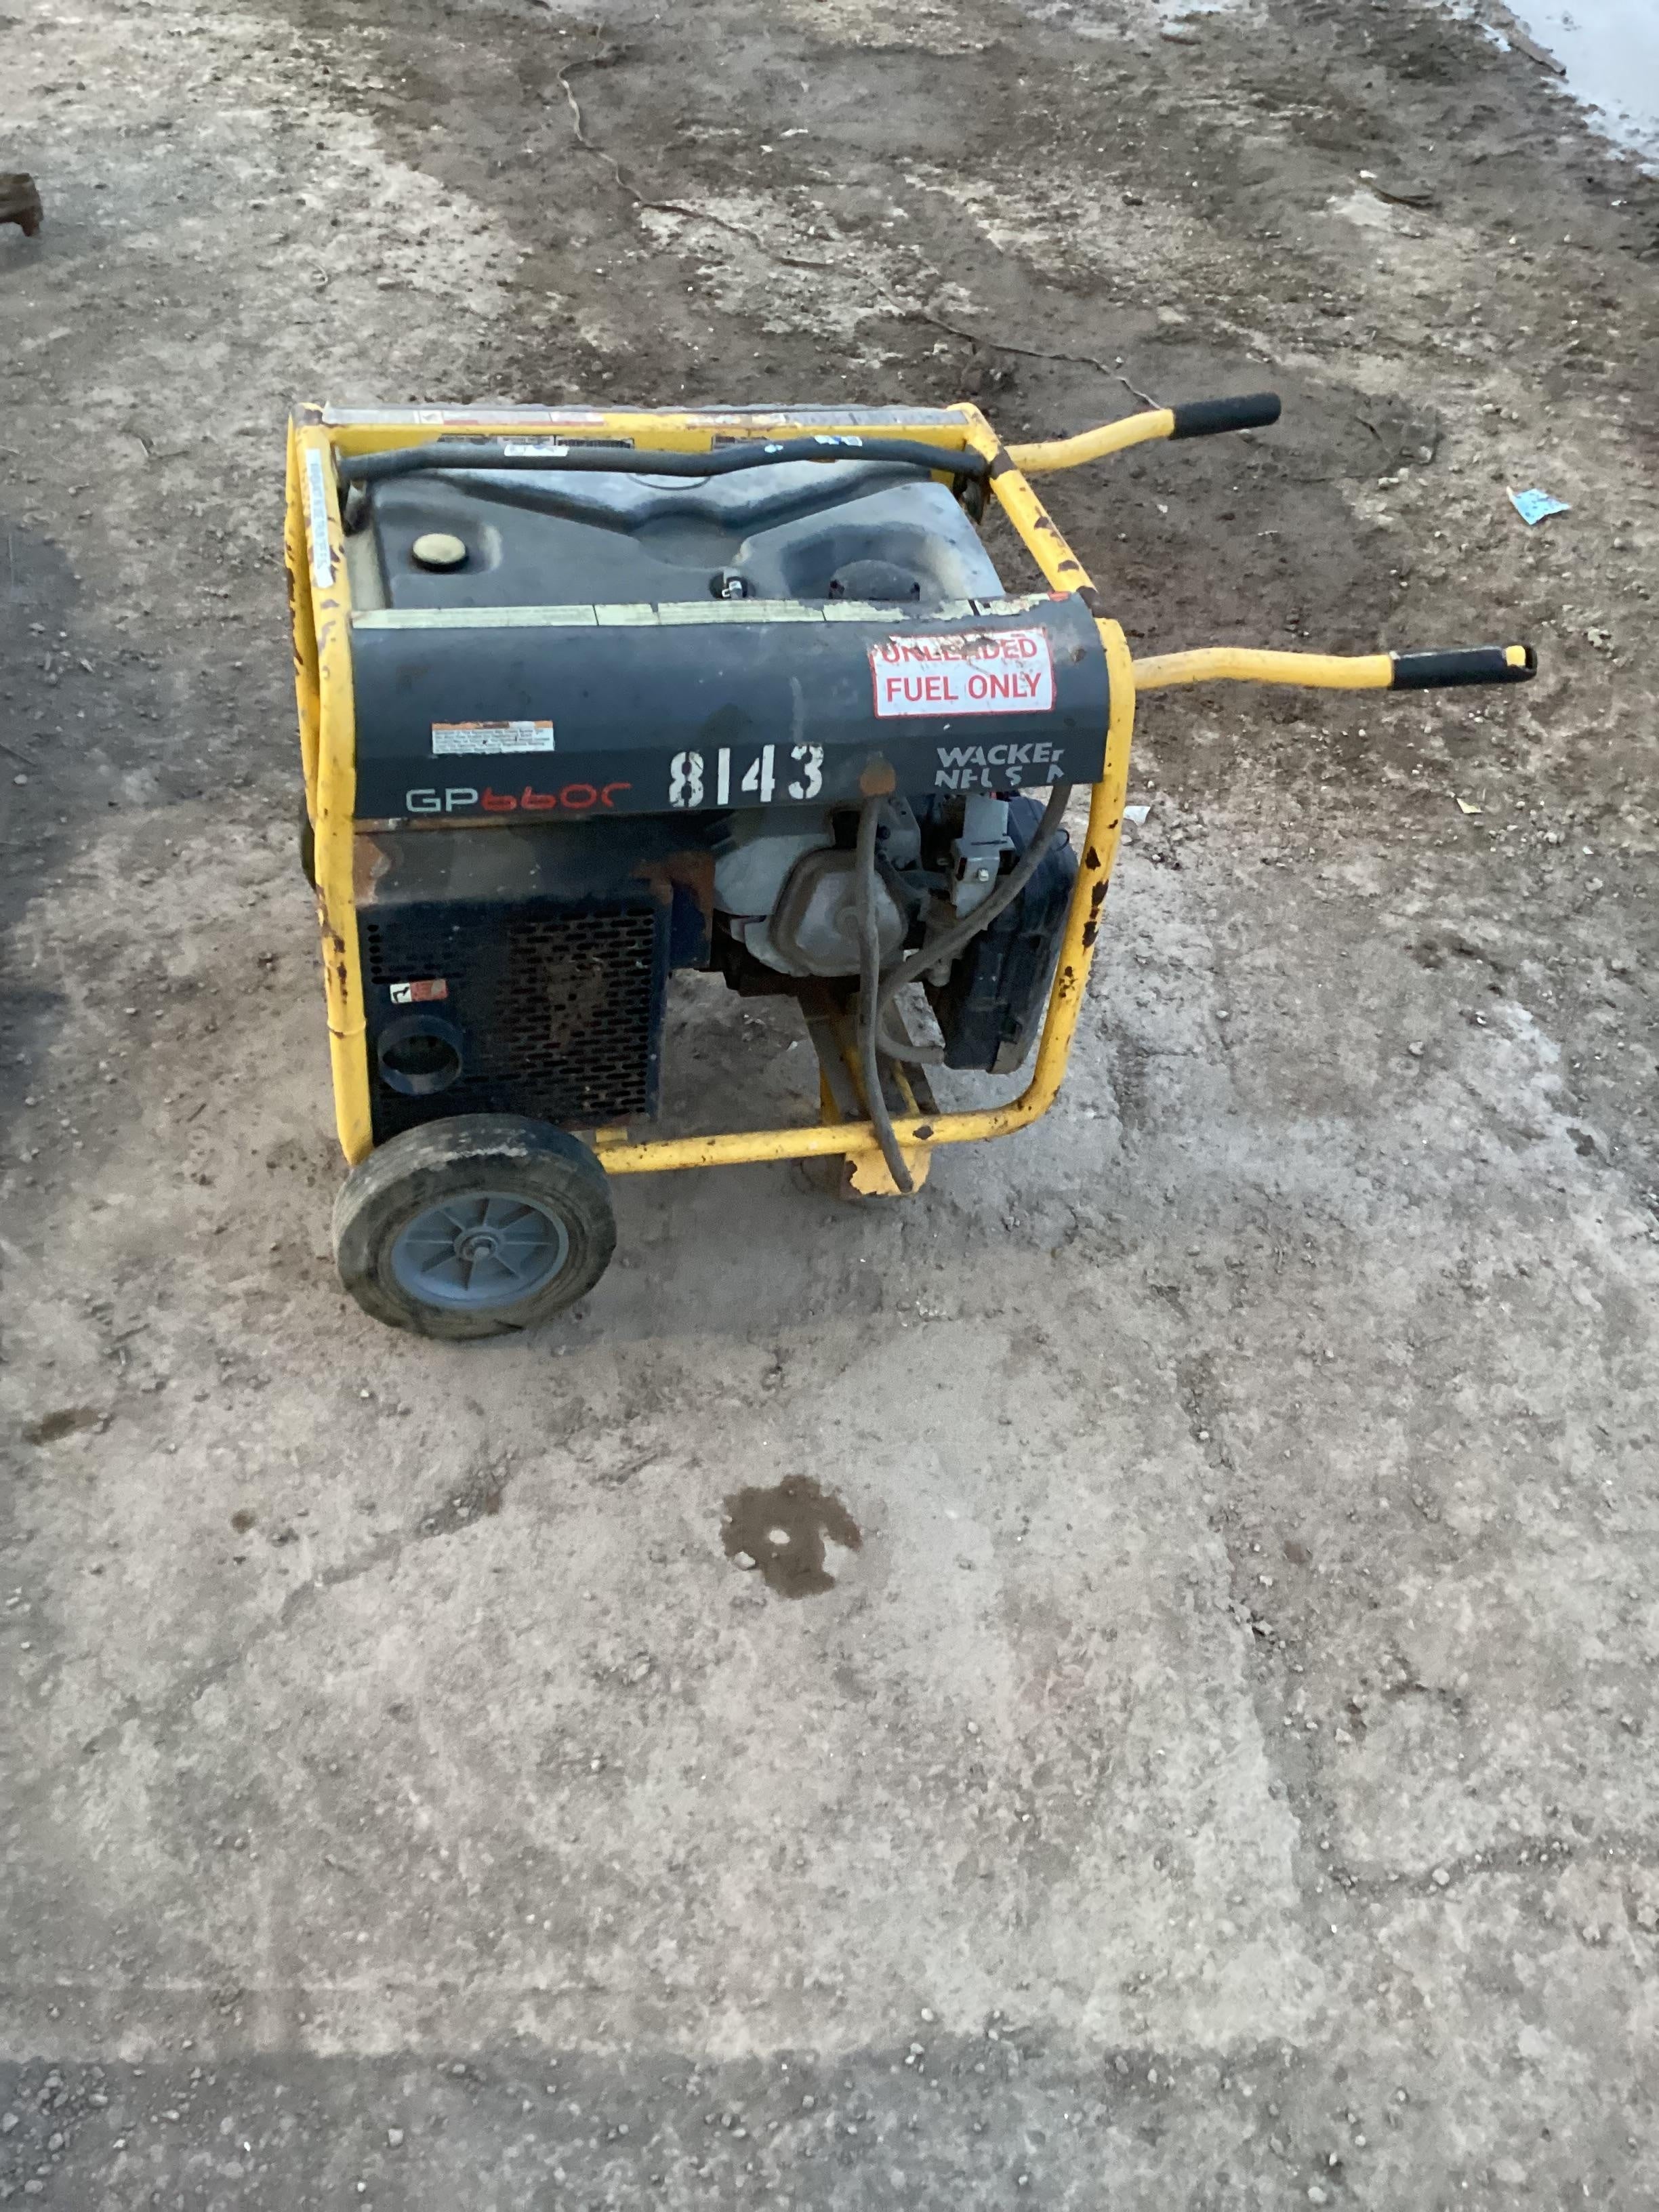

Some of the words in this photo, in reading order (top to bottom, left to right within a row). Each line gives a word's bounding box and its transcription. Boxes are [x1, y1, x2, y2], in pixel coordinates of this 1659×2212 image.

[882, 638, 1038, 663] UNLDED
[886, 676, 959, 702] FUEL
[968, 673, 1042, 699] ONLY
[669, 744, 825, 808] 8143
